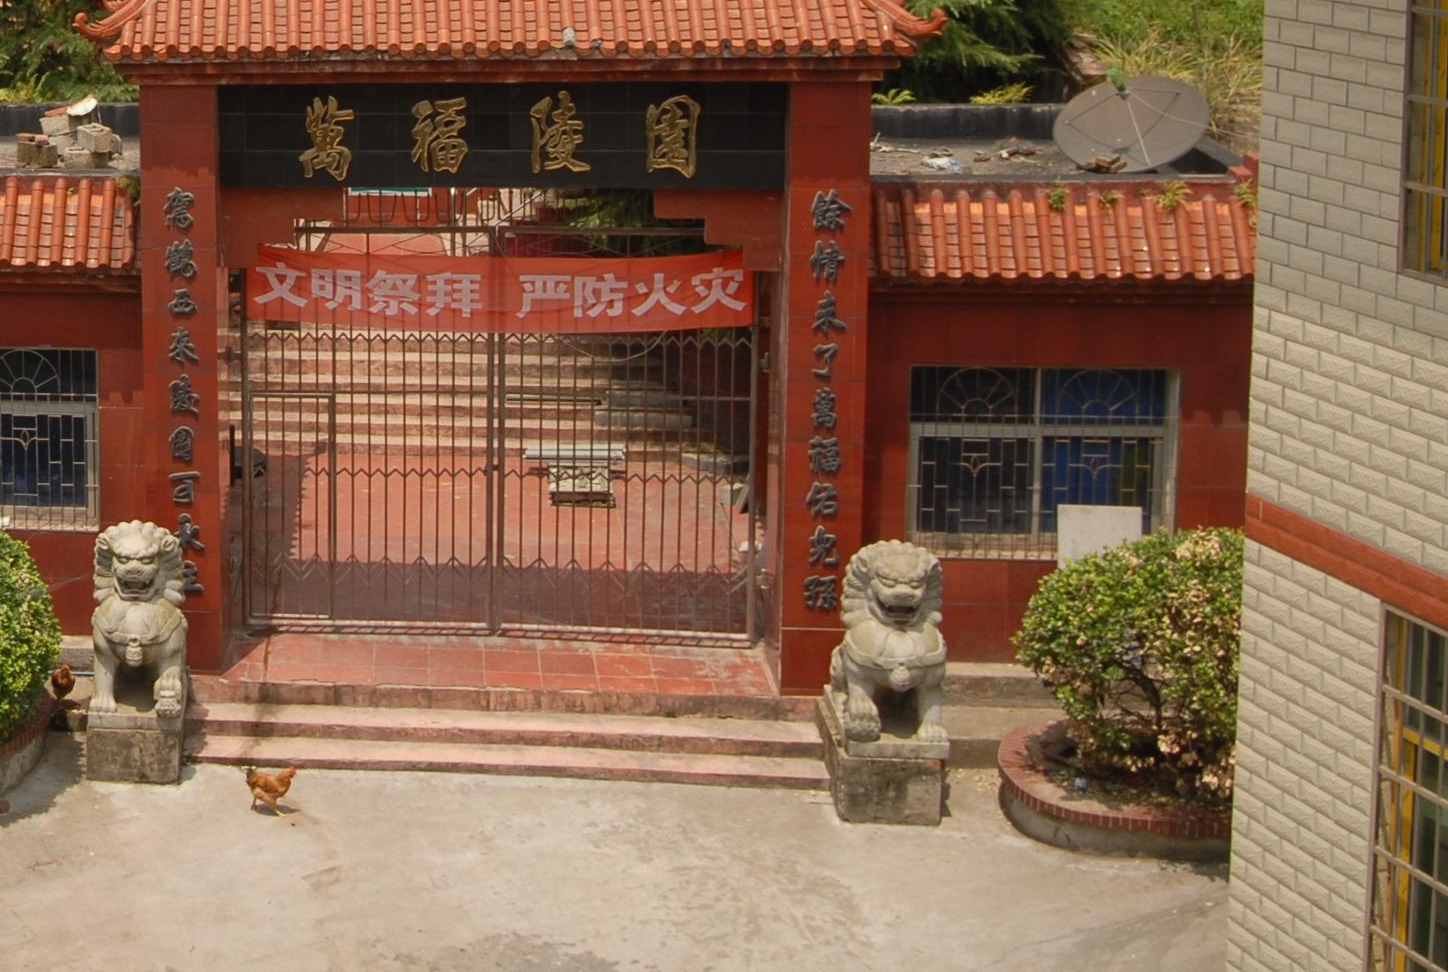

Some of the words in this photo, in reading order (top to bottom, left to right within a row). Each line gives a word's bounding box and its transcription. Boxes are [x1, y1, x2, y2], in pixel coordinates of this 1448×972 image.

[299, 90, 701, 181] 萬福陵園
[254, 262, 483, 319] 文明祭拜
[515, 267, 747, 319] 严防火灾
